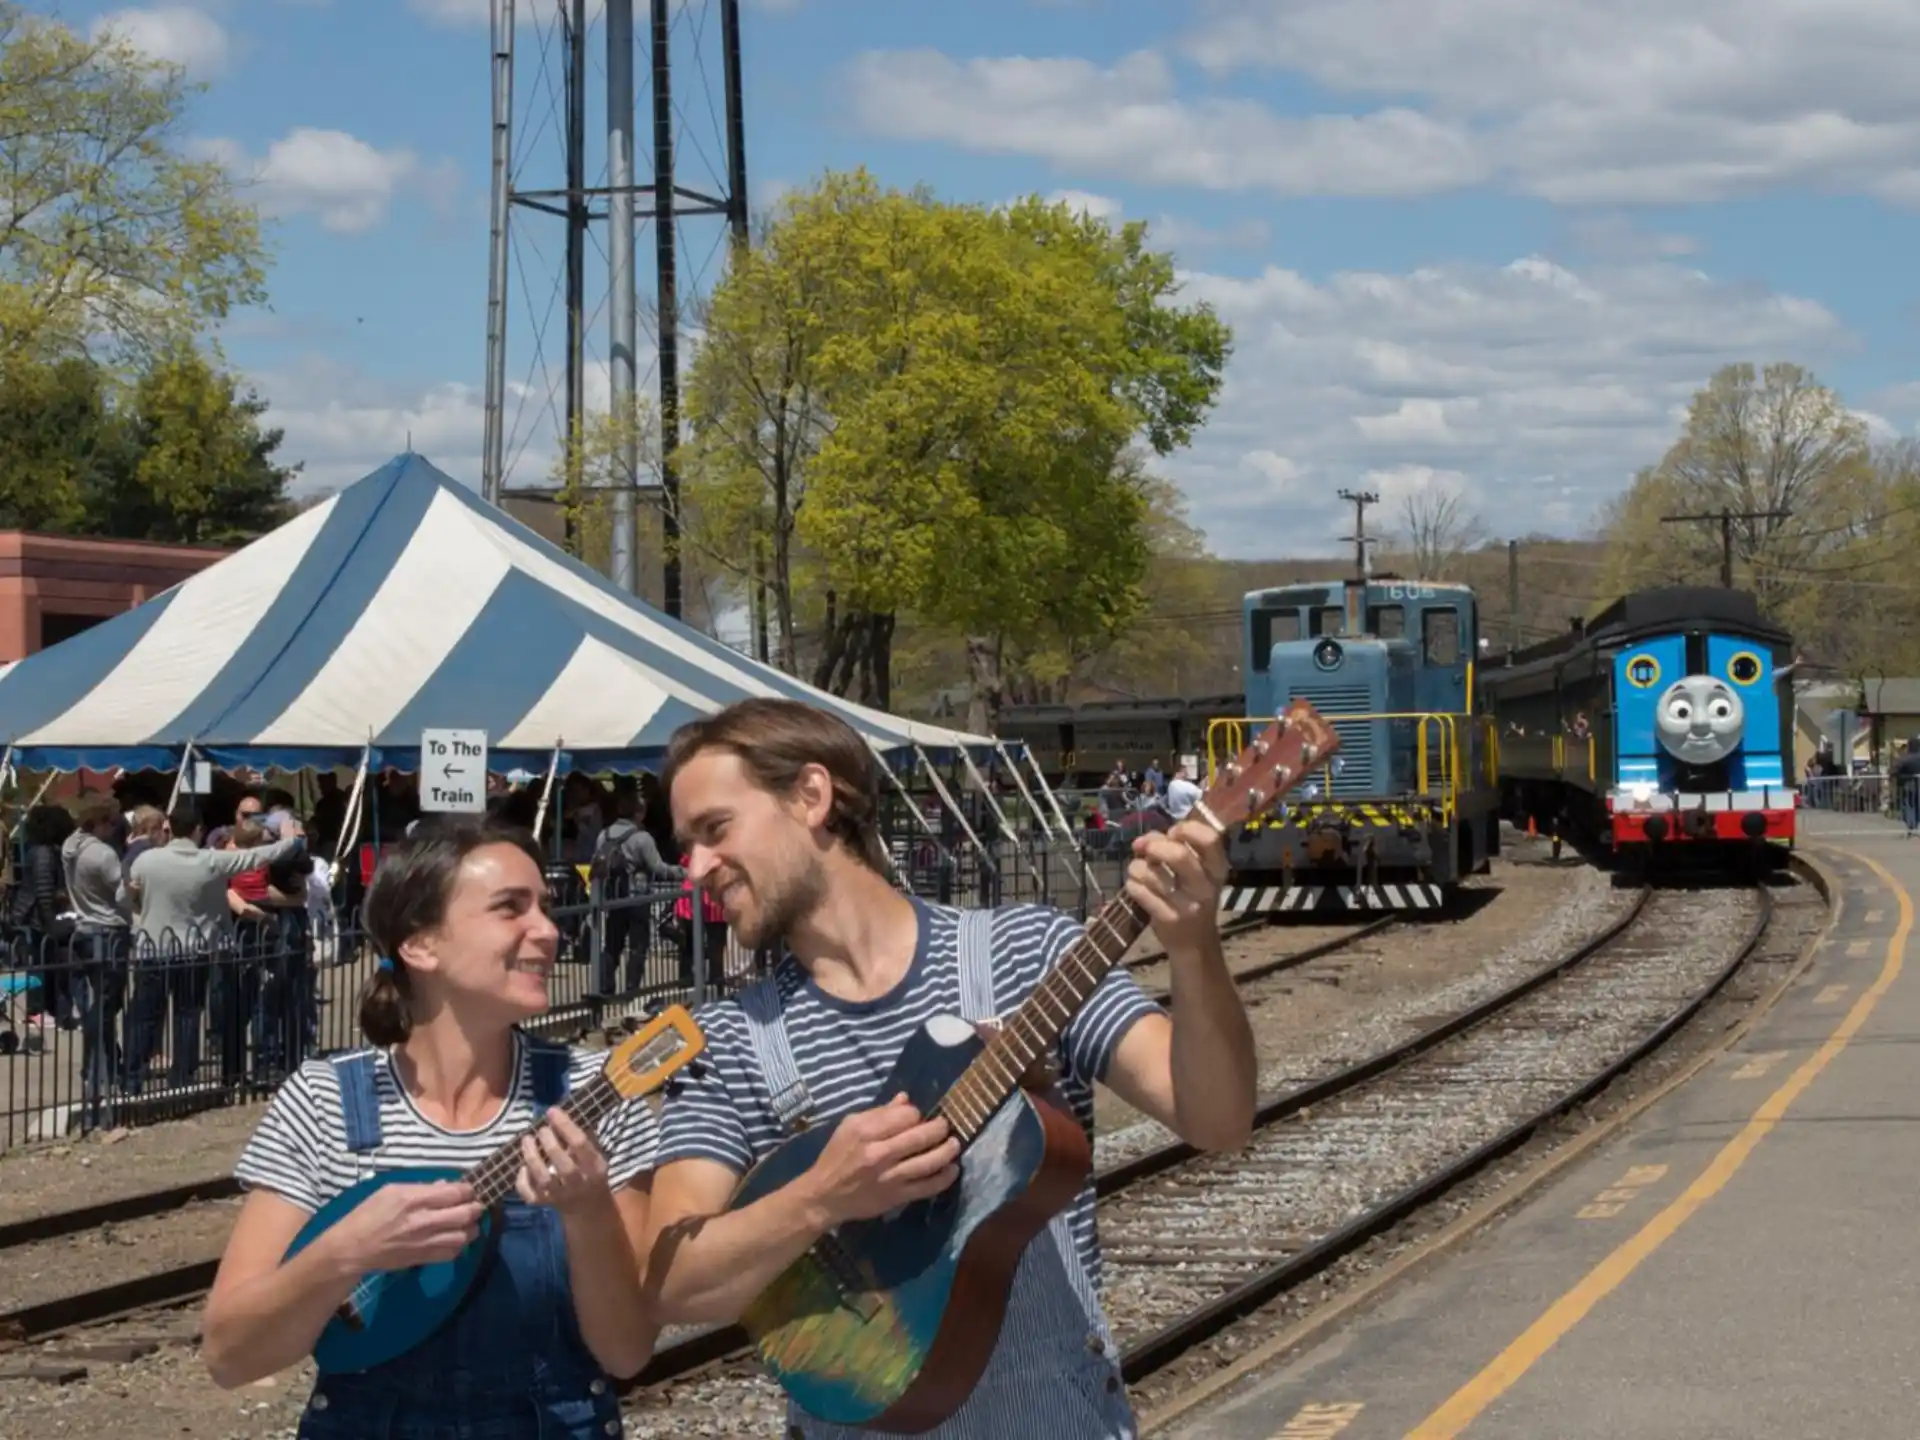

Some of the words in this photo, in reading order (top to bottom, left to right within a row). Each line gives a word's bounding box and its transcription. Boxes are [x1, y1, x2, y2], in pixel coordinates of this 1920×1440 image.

[429, 741, 447, 755] To
[452, 742, 482, 756] The
[431, 787, 474, 803] Train
